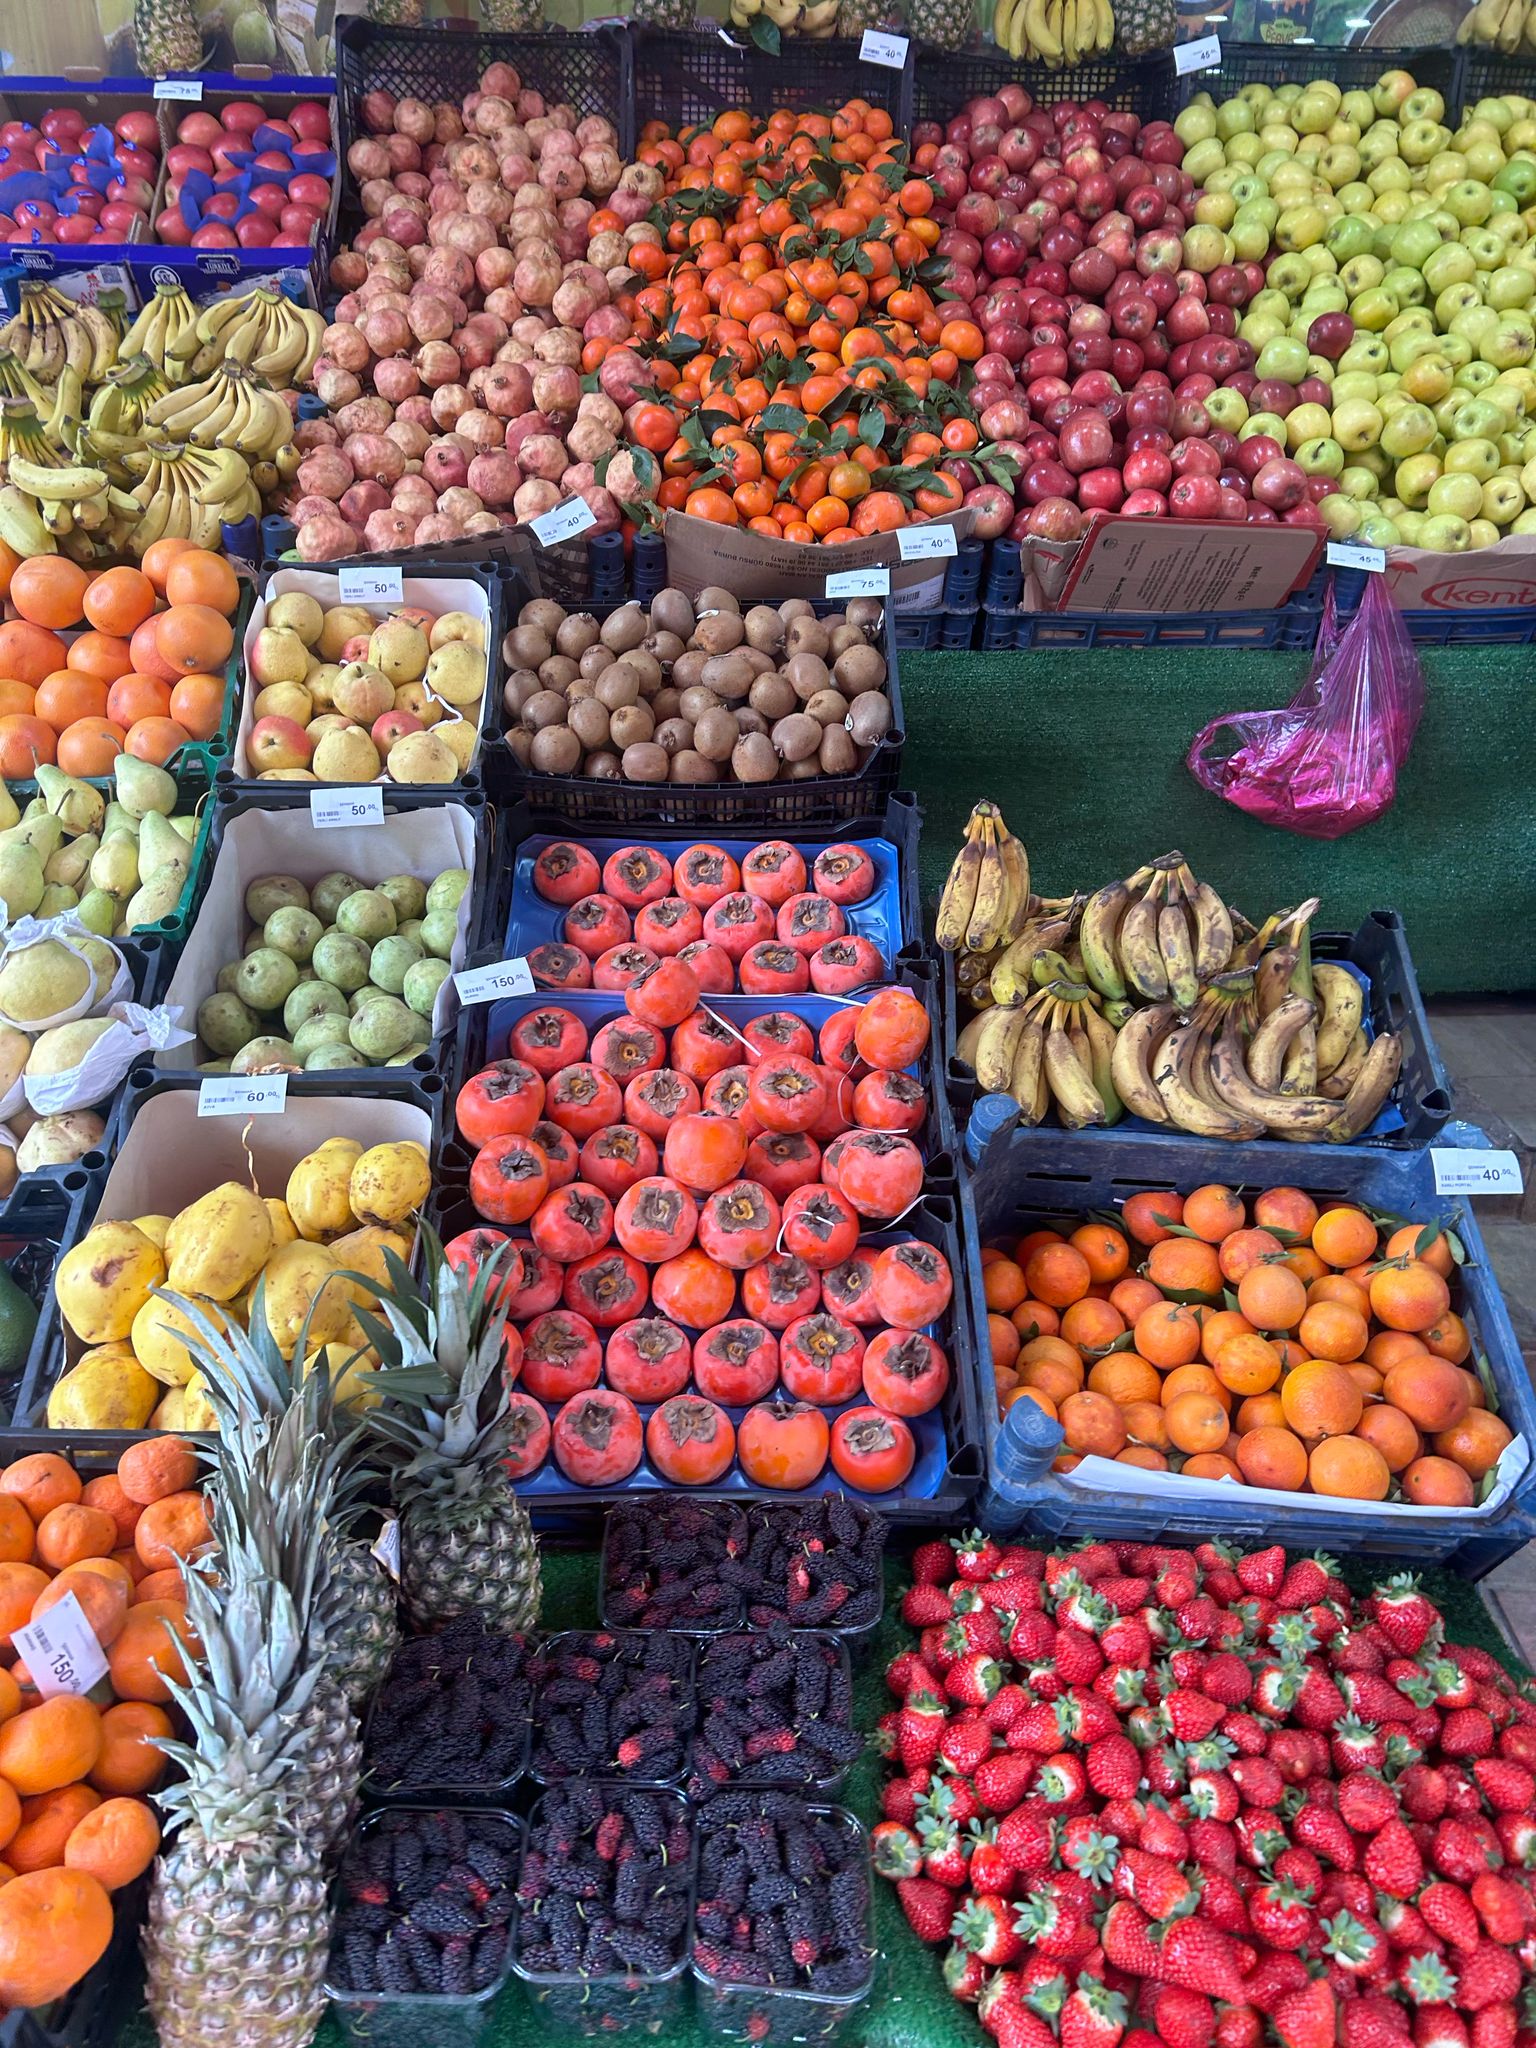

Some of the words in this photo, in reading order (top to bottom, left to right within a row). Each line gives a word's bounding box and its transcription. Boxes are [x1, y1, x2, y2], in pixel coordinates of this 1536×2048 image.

[885, 49, 896, 58] 40
[567, 516, 579, 527] 40
[931, 539, 943, 548] 40
[374, 583, 388, 593] 50
[862, 580, 875, 588] 75
[1443, 585, 1536, 605] kent
[351, 804, 366, 815] 50
[491, 976, 515, 989] 150
[247, 1092, 265, 1102] 60
[1482, 1169, 1500, 1181] 40
[50, 1654, 74, 1683] 150
